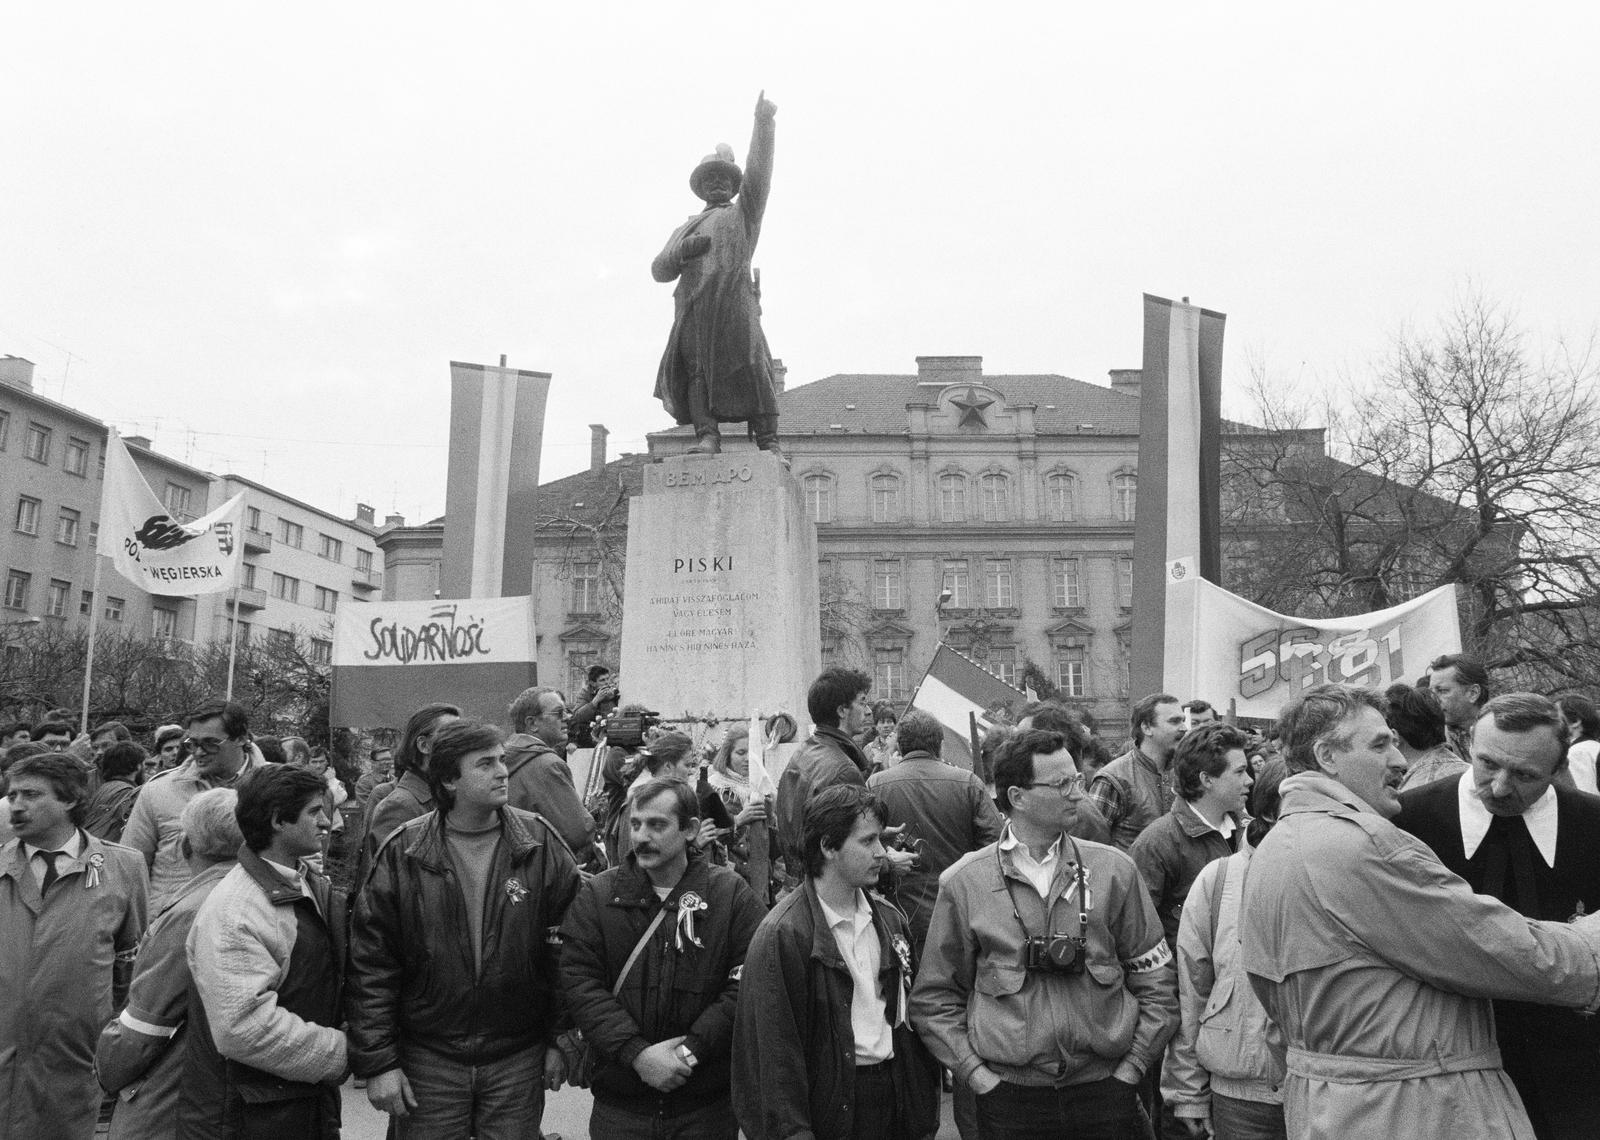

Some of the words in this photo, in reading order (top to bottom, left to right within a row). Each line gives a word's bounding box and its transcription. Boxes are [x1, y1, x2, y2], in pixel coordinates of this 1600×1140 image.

[665, 471, 707, 488] BEM
[711, 464, 753, 485] APÓ
[674, 556, 733, 573] PISKI
